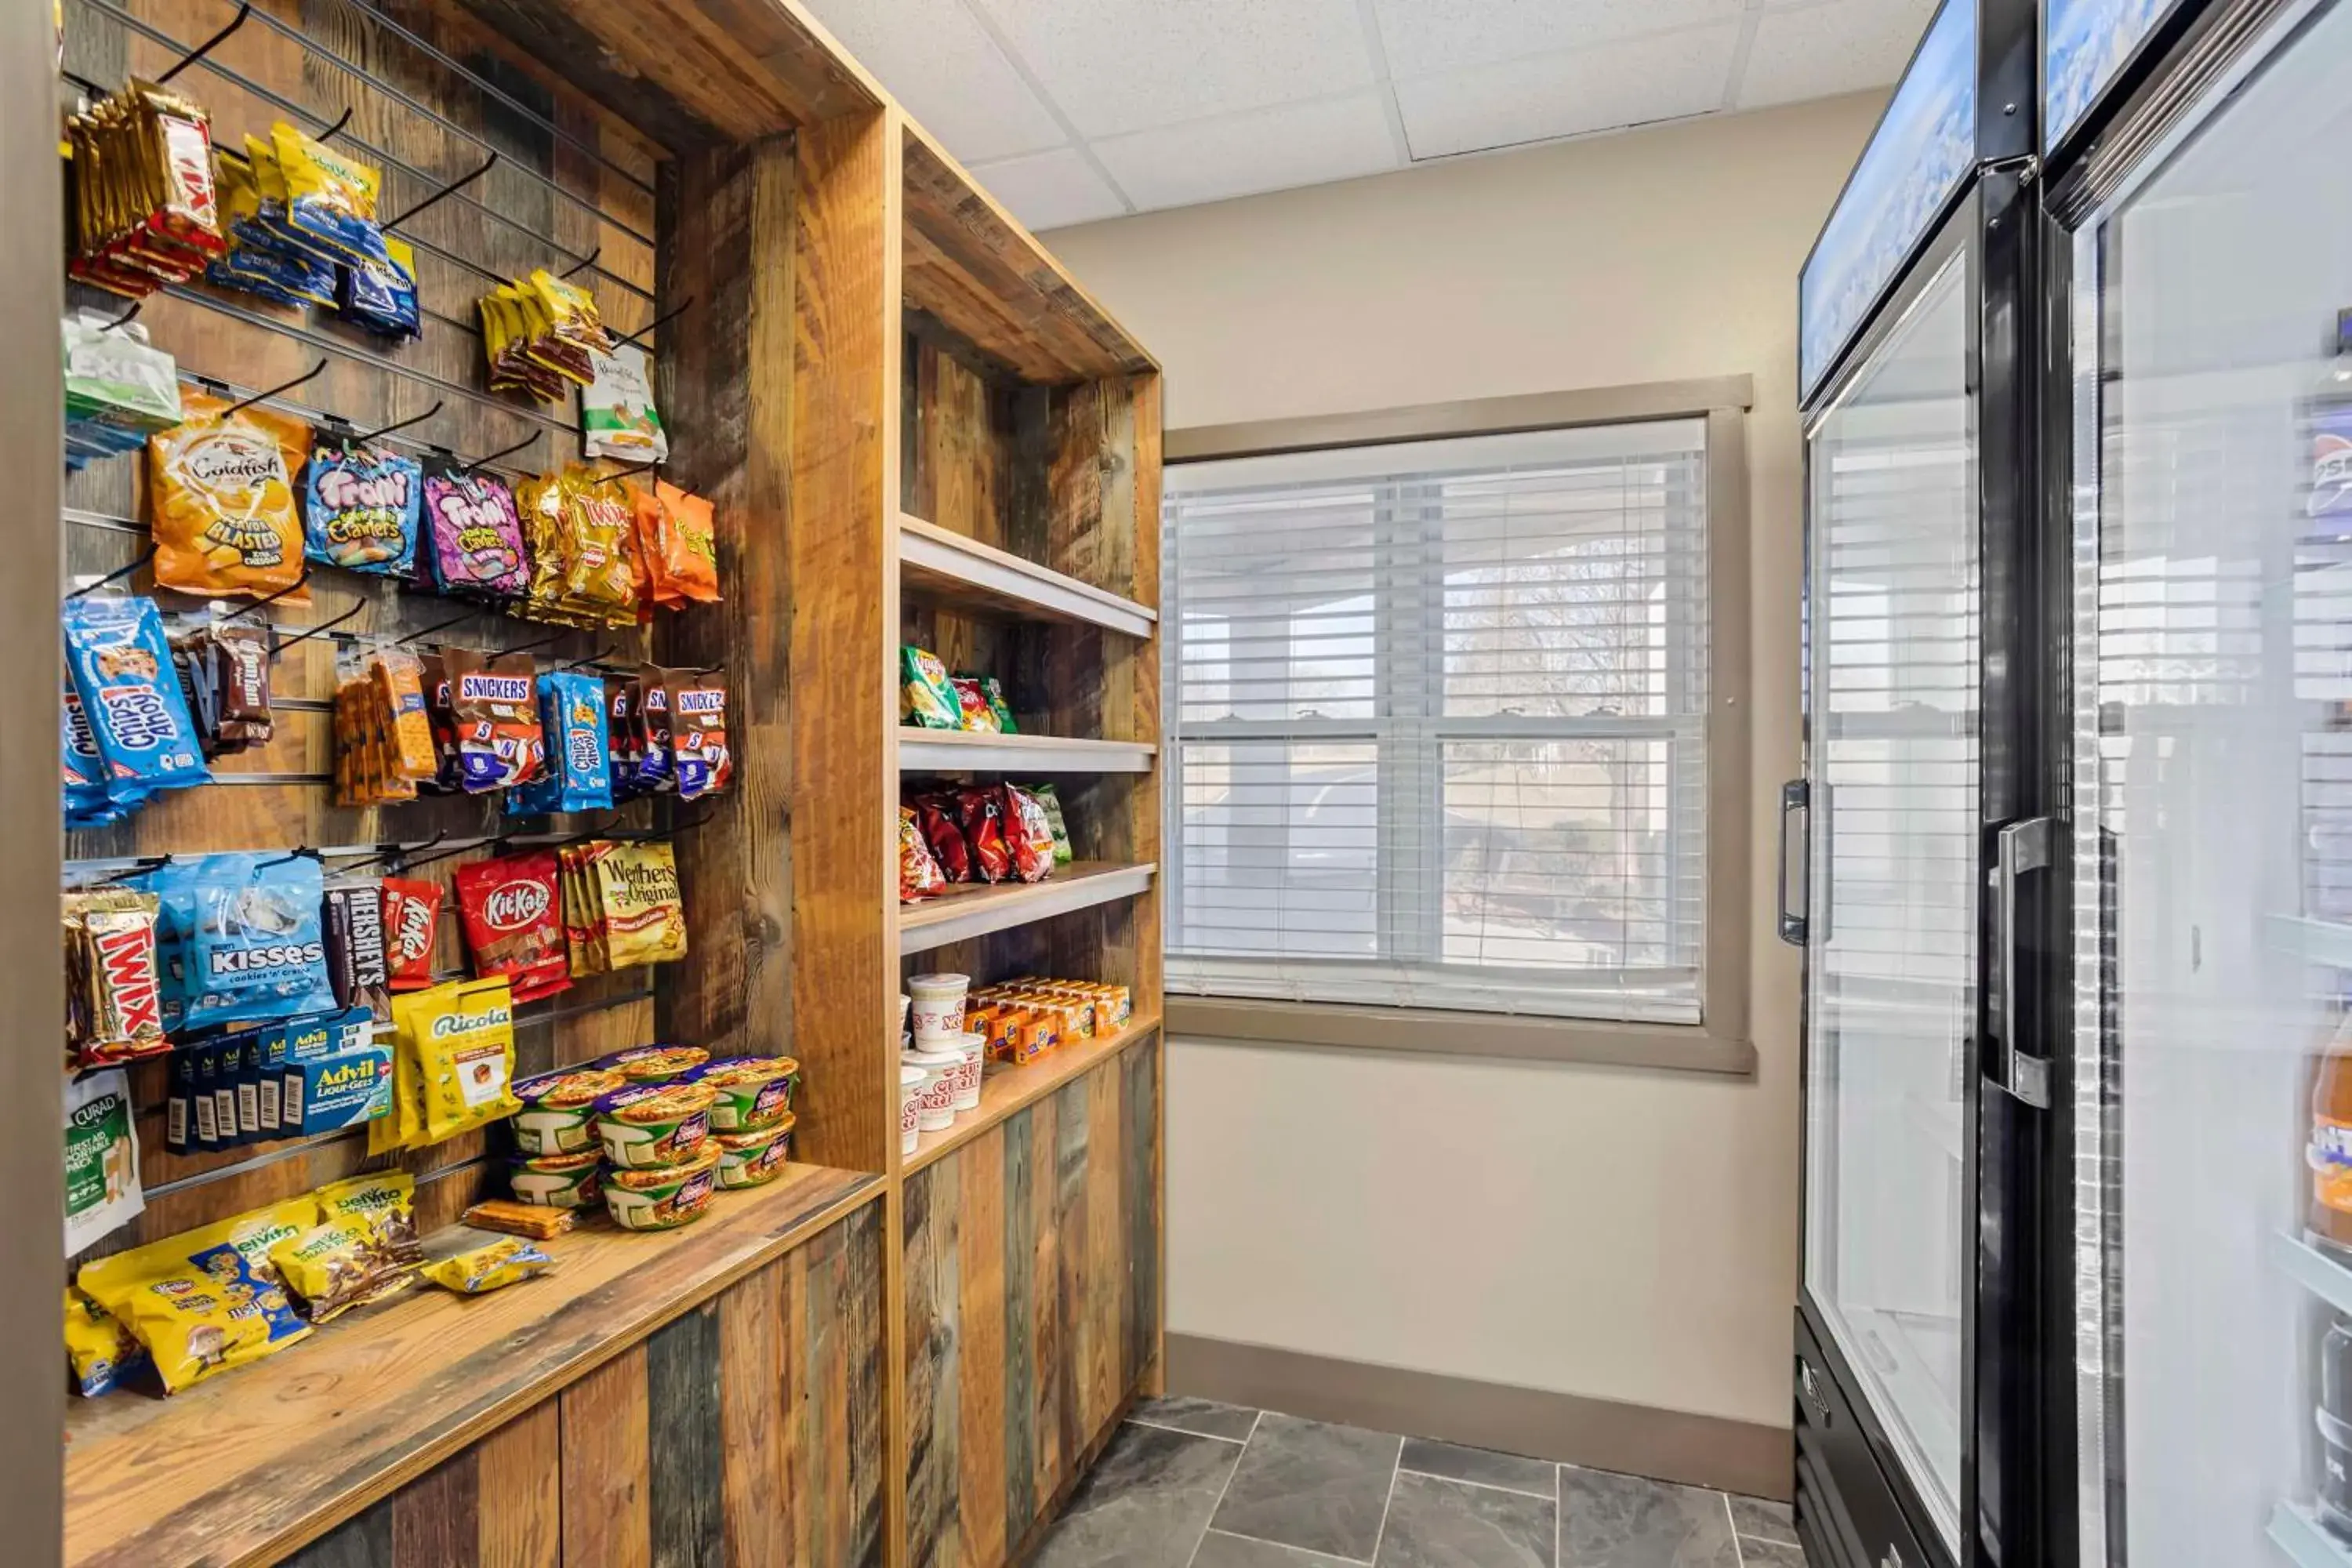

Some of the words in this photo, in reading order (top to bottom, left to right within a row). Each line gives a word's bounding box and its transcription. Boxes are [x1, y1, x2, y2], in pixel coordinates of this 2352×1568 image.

[192, 457, 279, 479] Goldfish
[318, 470, 407, 509] Trolli
[440, 495, 508, 530] Trolli
[206, 521, 282, 550] BLASTED
[463, 677, 528, 699] SNICKERS
[109, 698, 156, 749] Chips
[488, 887, 548, 927] KitKat
[350, 890, 385, 986] HERSHEY'S
[400, 897, 430, 960] KitKat
[96, 926, 159, 1037] TWIX
[433, 1007, 509, 1037] Ricola
[296, 1030, 327, 1047] Advil
[315, 1059, 374, 1088] Advil
[75, 1097, 116, 1126] CURAD
[238, 1225, 300, 1253] elVita
